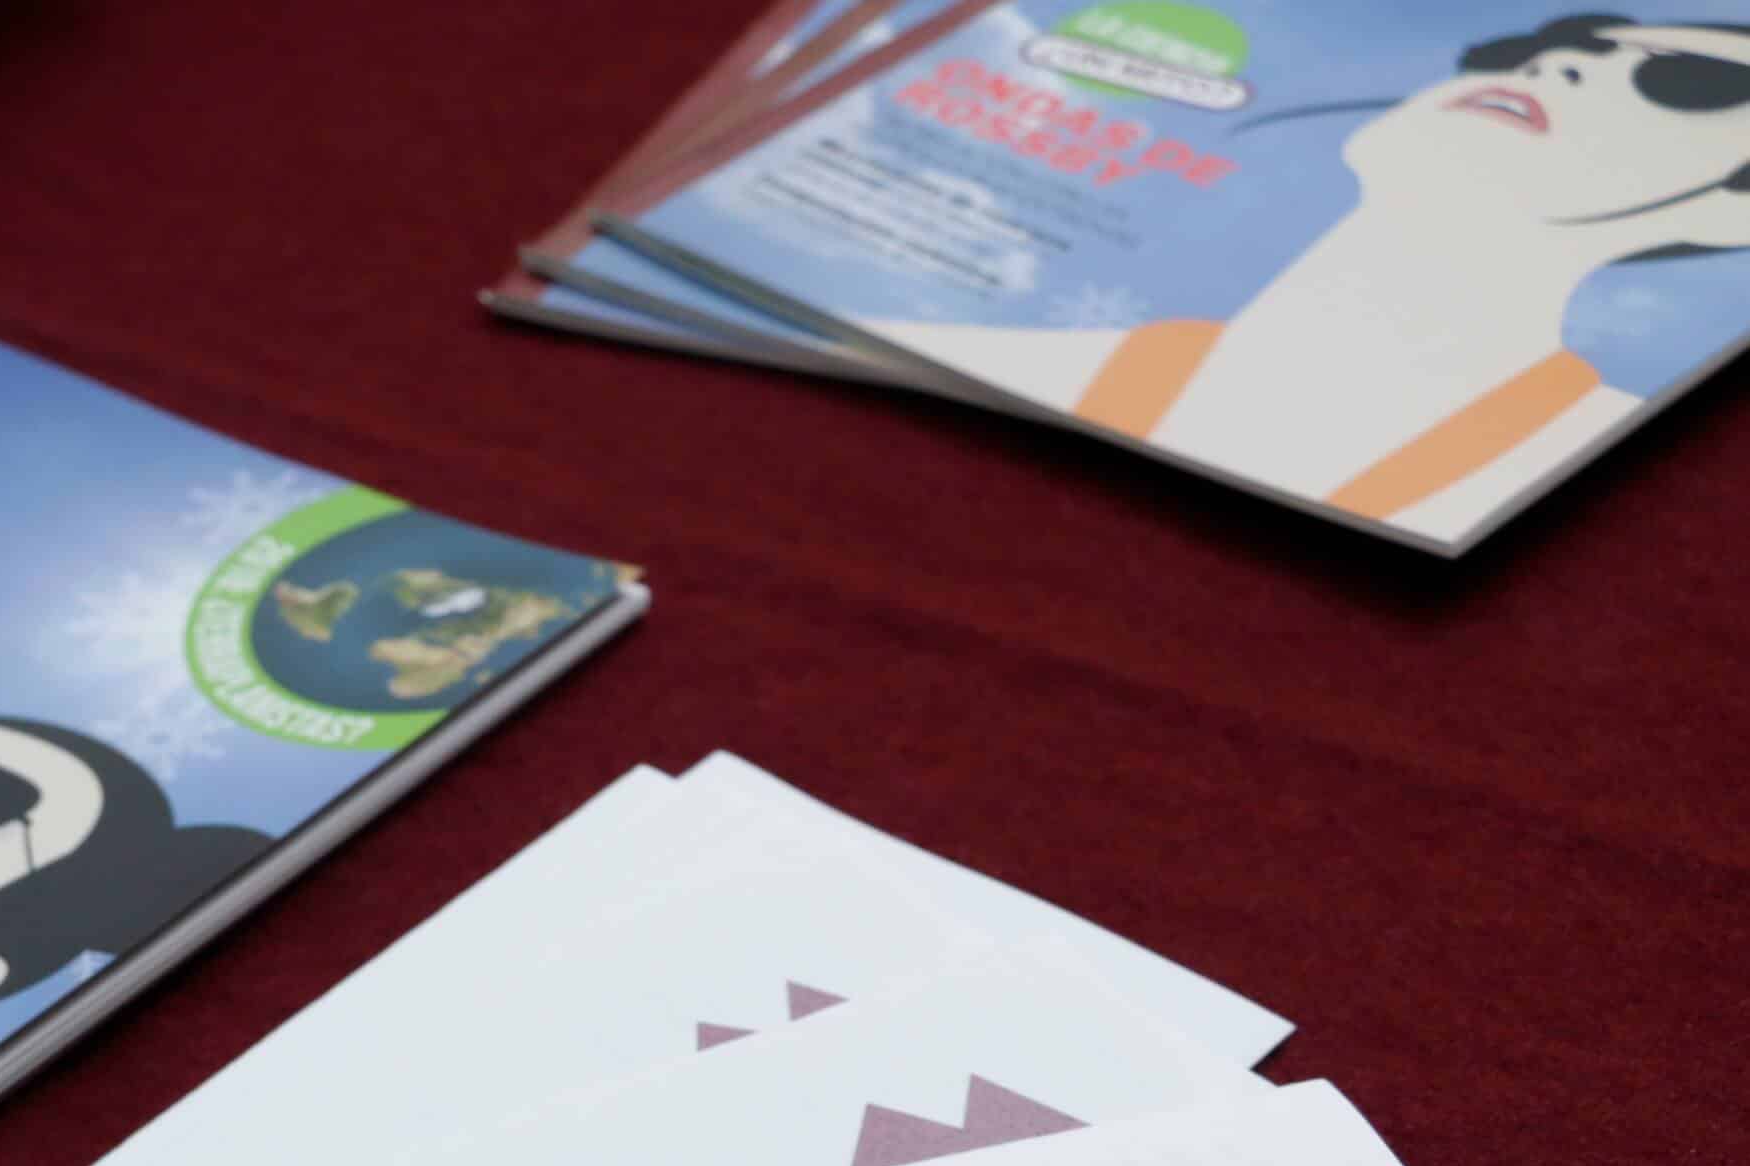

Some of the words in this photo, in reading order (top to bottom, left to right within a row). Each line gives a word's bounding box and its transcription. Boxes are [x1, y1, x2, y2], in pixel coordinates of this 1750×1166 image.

[894, 80, 1142, 188] ROSSBY
[934, 58, 1146, 150] ONDAS
[1138, 137, 1240, 188] DE
